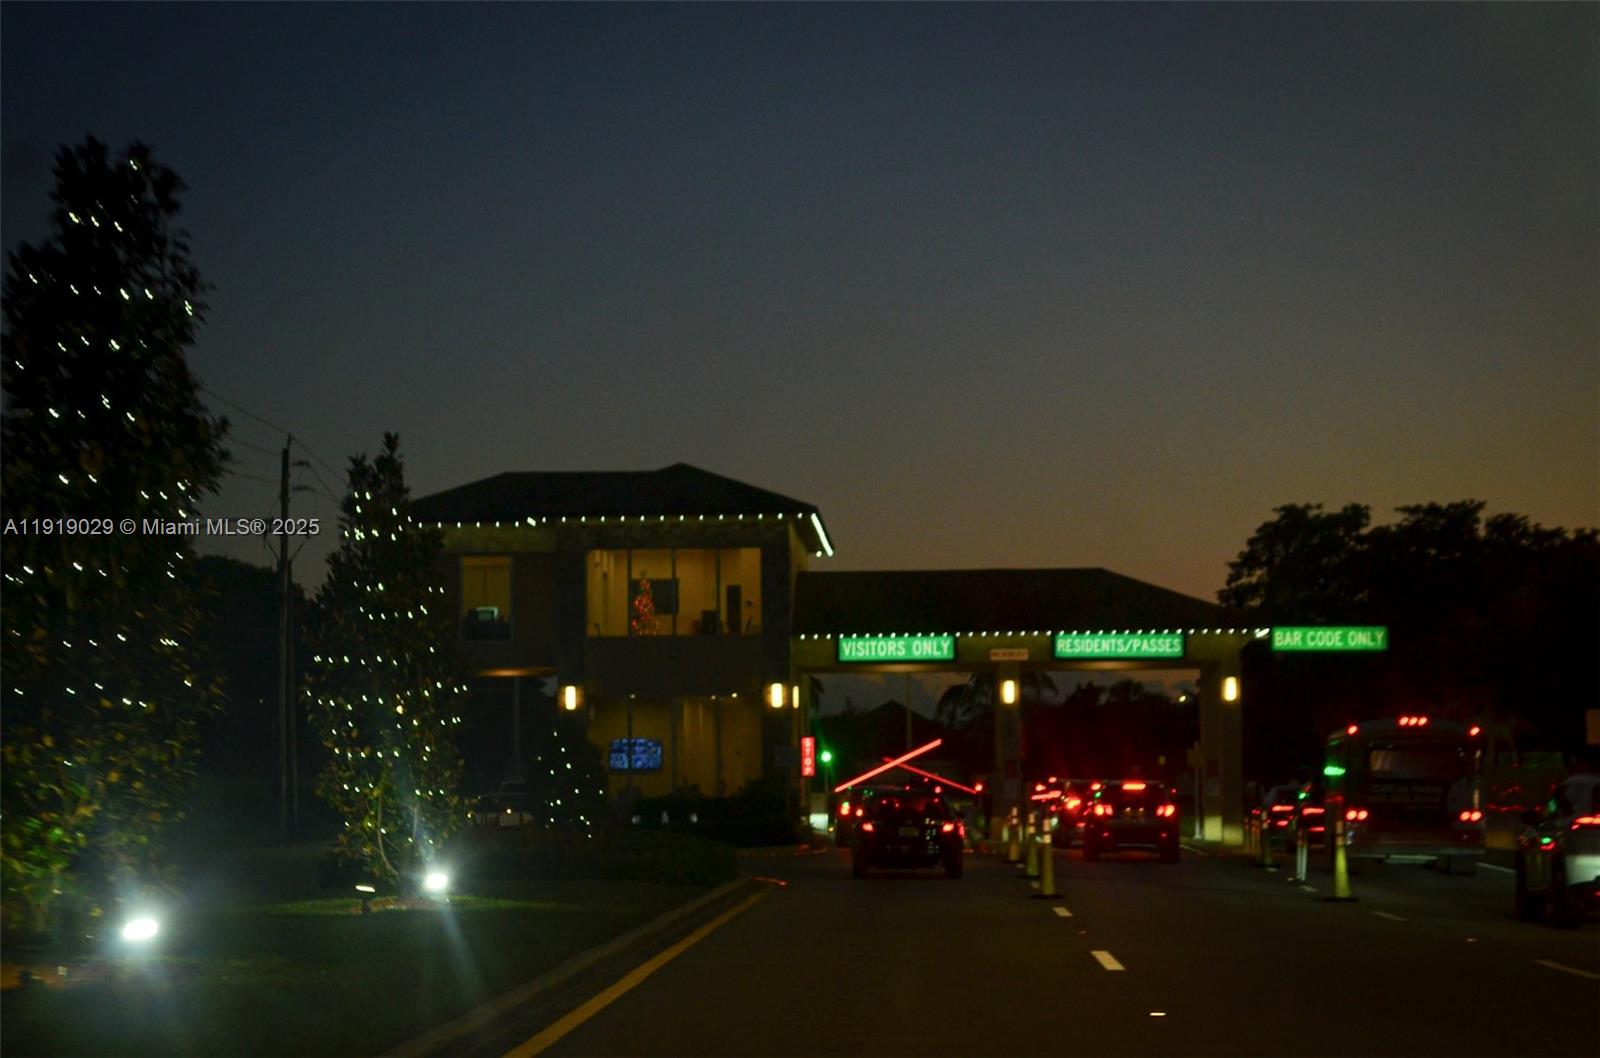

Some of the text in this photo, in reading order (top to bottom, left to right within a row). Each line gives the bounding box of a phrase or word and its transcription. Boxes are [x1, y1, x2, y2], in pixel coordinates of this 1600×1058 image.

[1056, 637, 1182, 653] RESIDENTS/PASSES
[1274, 631, 1384, 647] BAR CODE ONLY
[842, 639, 950, 657] VISITORS ONLY
